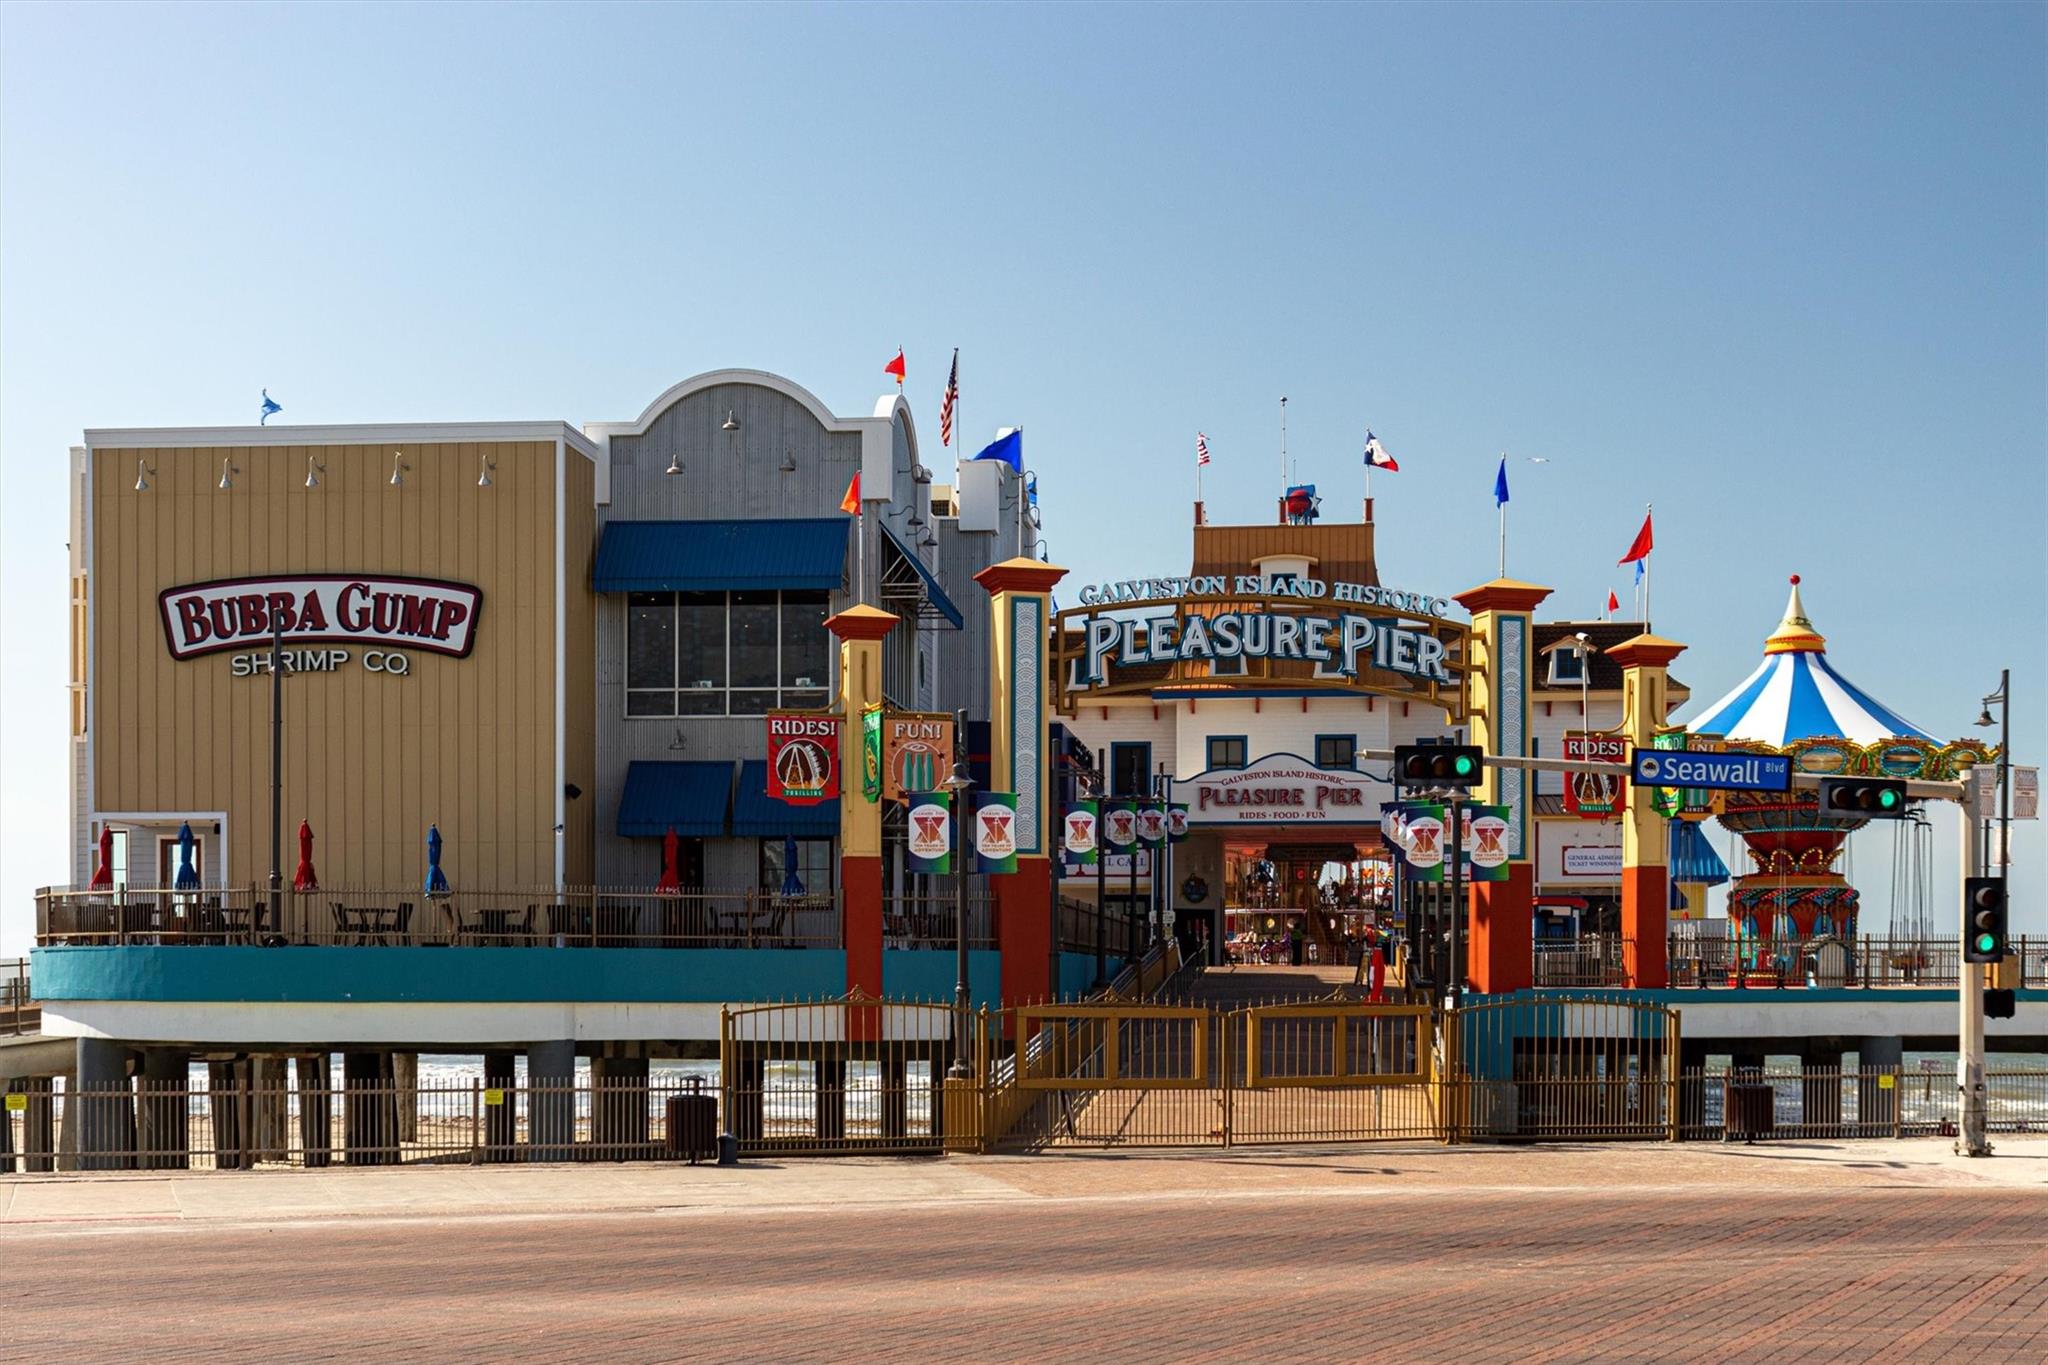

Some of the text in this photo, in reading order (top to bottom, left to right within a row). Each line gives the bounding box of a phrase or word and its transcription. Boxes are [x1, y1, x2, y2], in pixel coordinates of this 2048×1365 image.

[1080, 575, 1449, 617] GALVESTON ISLAND HISTORIC
[177, 582, 467, 646] BUBBA GUMP
[1083, 612, 1449, 684] PLEASURE PIER
[231, 649, 350, 676] SHRIMP
[771, 719, 835, 736] RIDES!
[895, 722, 942, 739] FUN!
[1568, 741, 1623, 756] RIDES!
[1221, 769, 1345, 787] GALVESTON ISLAND HISTORIC
[1664, 758, 1785, 784] Seawall Blvd
[1199, 786, 1363, 811] PLEASURE PIER
